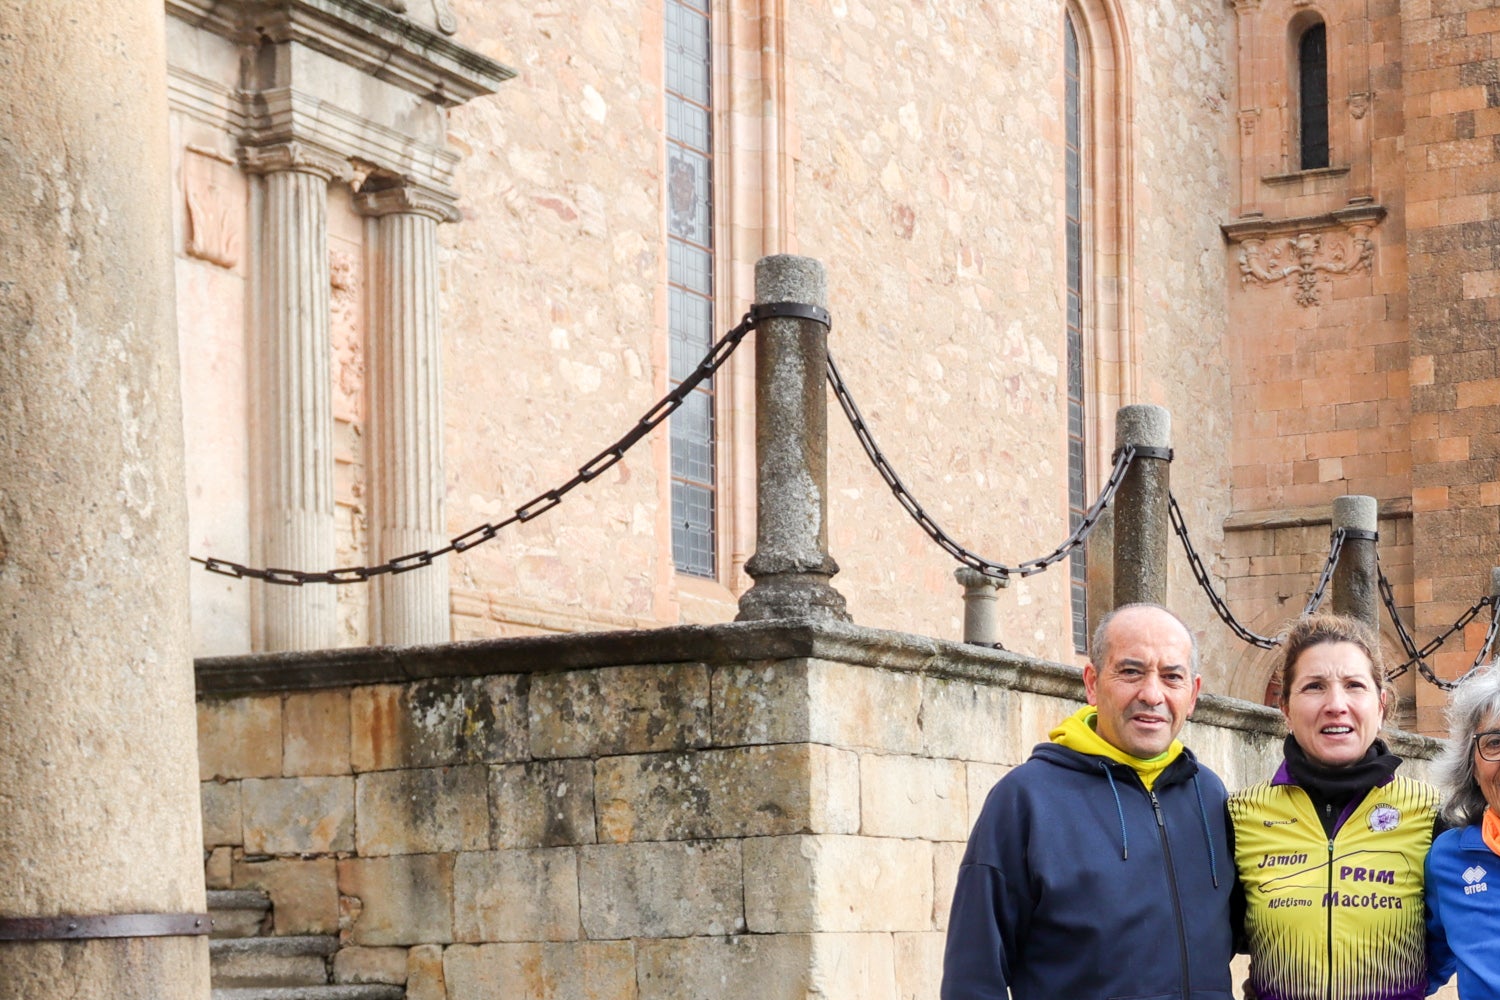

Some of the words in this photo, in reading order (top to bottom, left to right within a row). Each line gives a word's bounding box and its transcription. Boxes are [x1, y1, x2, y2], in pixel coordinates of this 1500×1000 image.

[1258, 851, 1308, 869] Jamón
[1340, 866, 1395, 885] PRIM
[1268, 897, 1313, 909] Atletismo
[1322, 891, 1403, 910] Macotera
